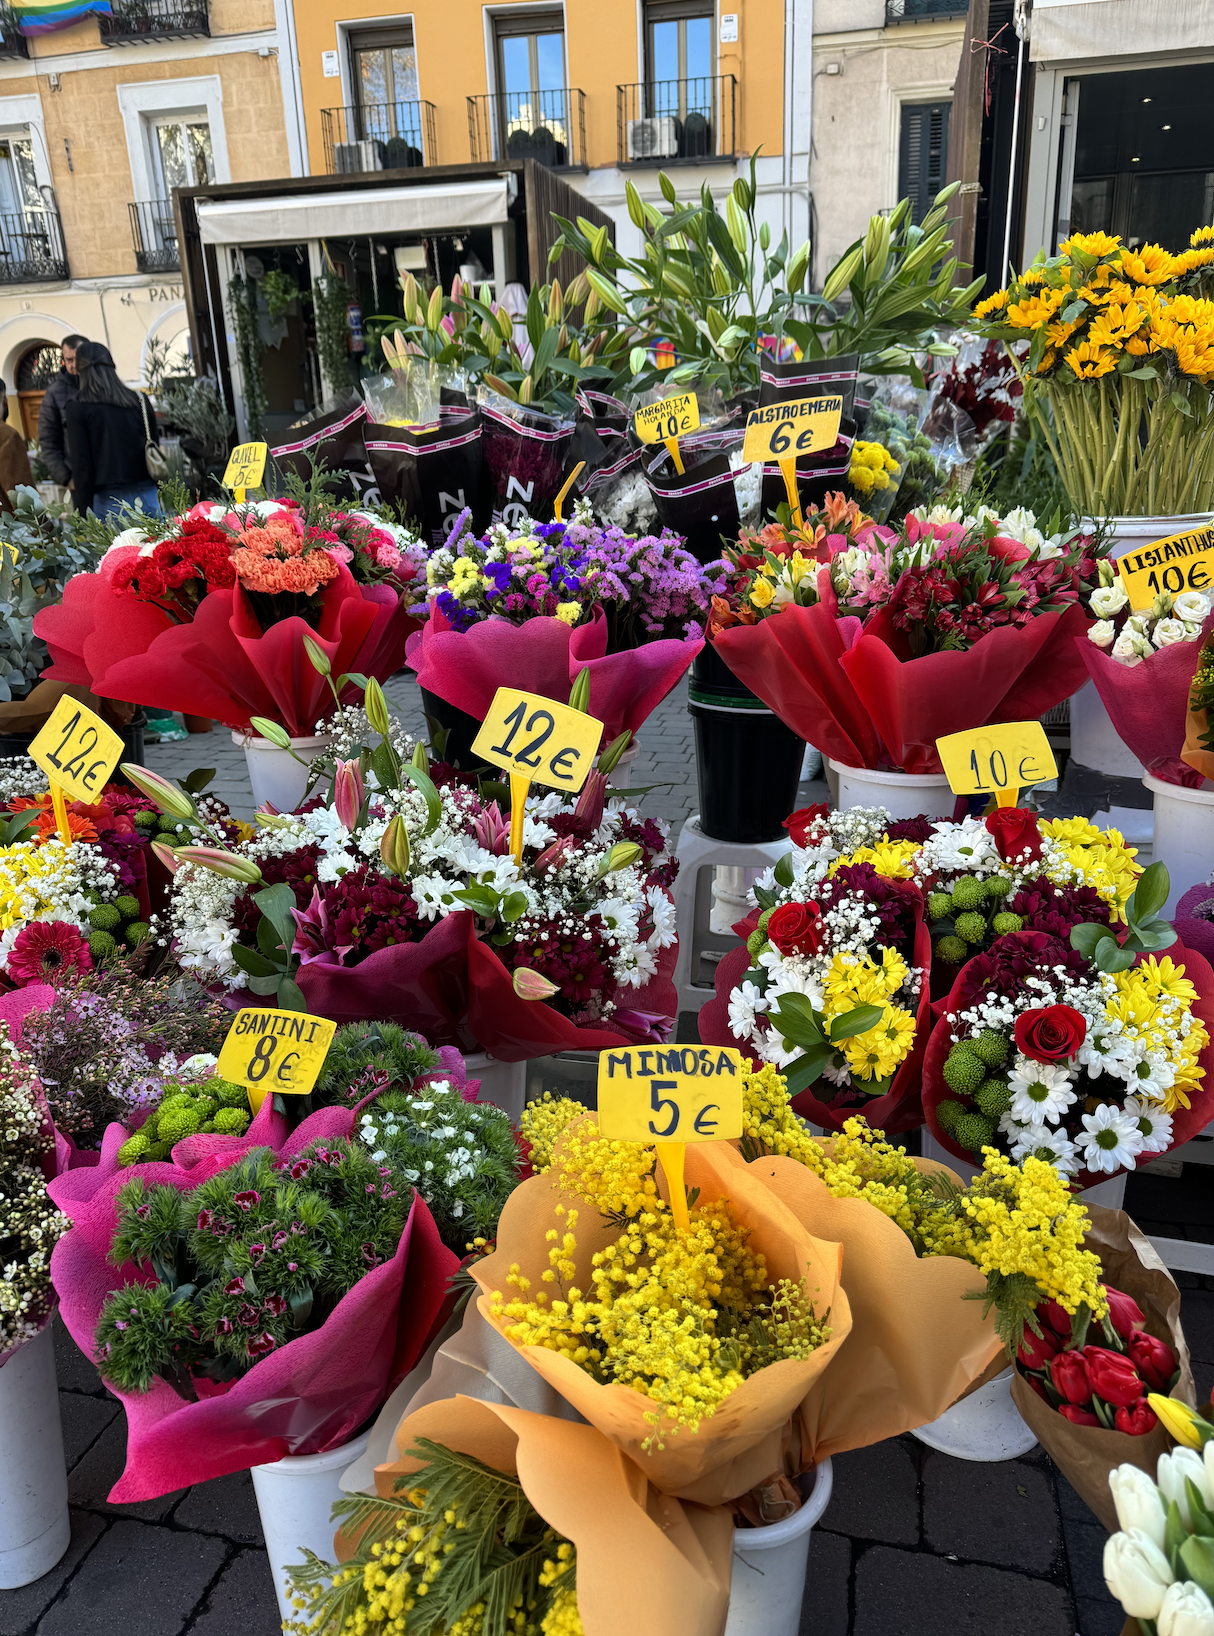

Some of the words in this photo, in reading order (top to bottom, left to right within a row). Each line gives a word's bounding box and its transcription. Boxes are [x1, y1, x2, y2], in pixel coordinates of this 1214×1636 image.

[149, 285, 186, 302] PAN
[636, 396, 691, 420] MARGARITA
[643, 406, 686, 426] HOLANDA
[655, 415, 693, 441] 10€
[769, 421, 814, 454] 6€
[1147, 561, 1212, 600] 10€
[45, 710, 107, 792] 12€
[490, 700, 581, 780] 12€
[235, 1013, 322, 1043] SANTINI
[607, 1048, 737, 1079] MIMOSA
